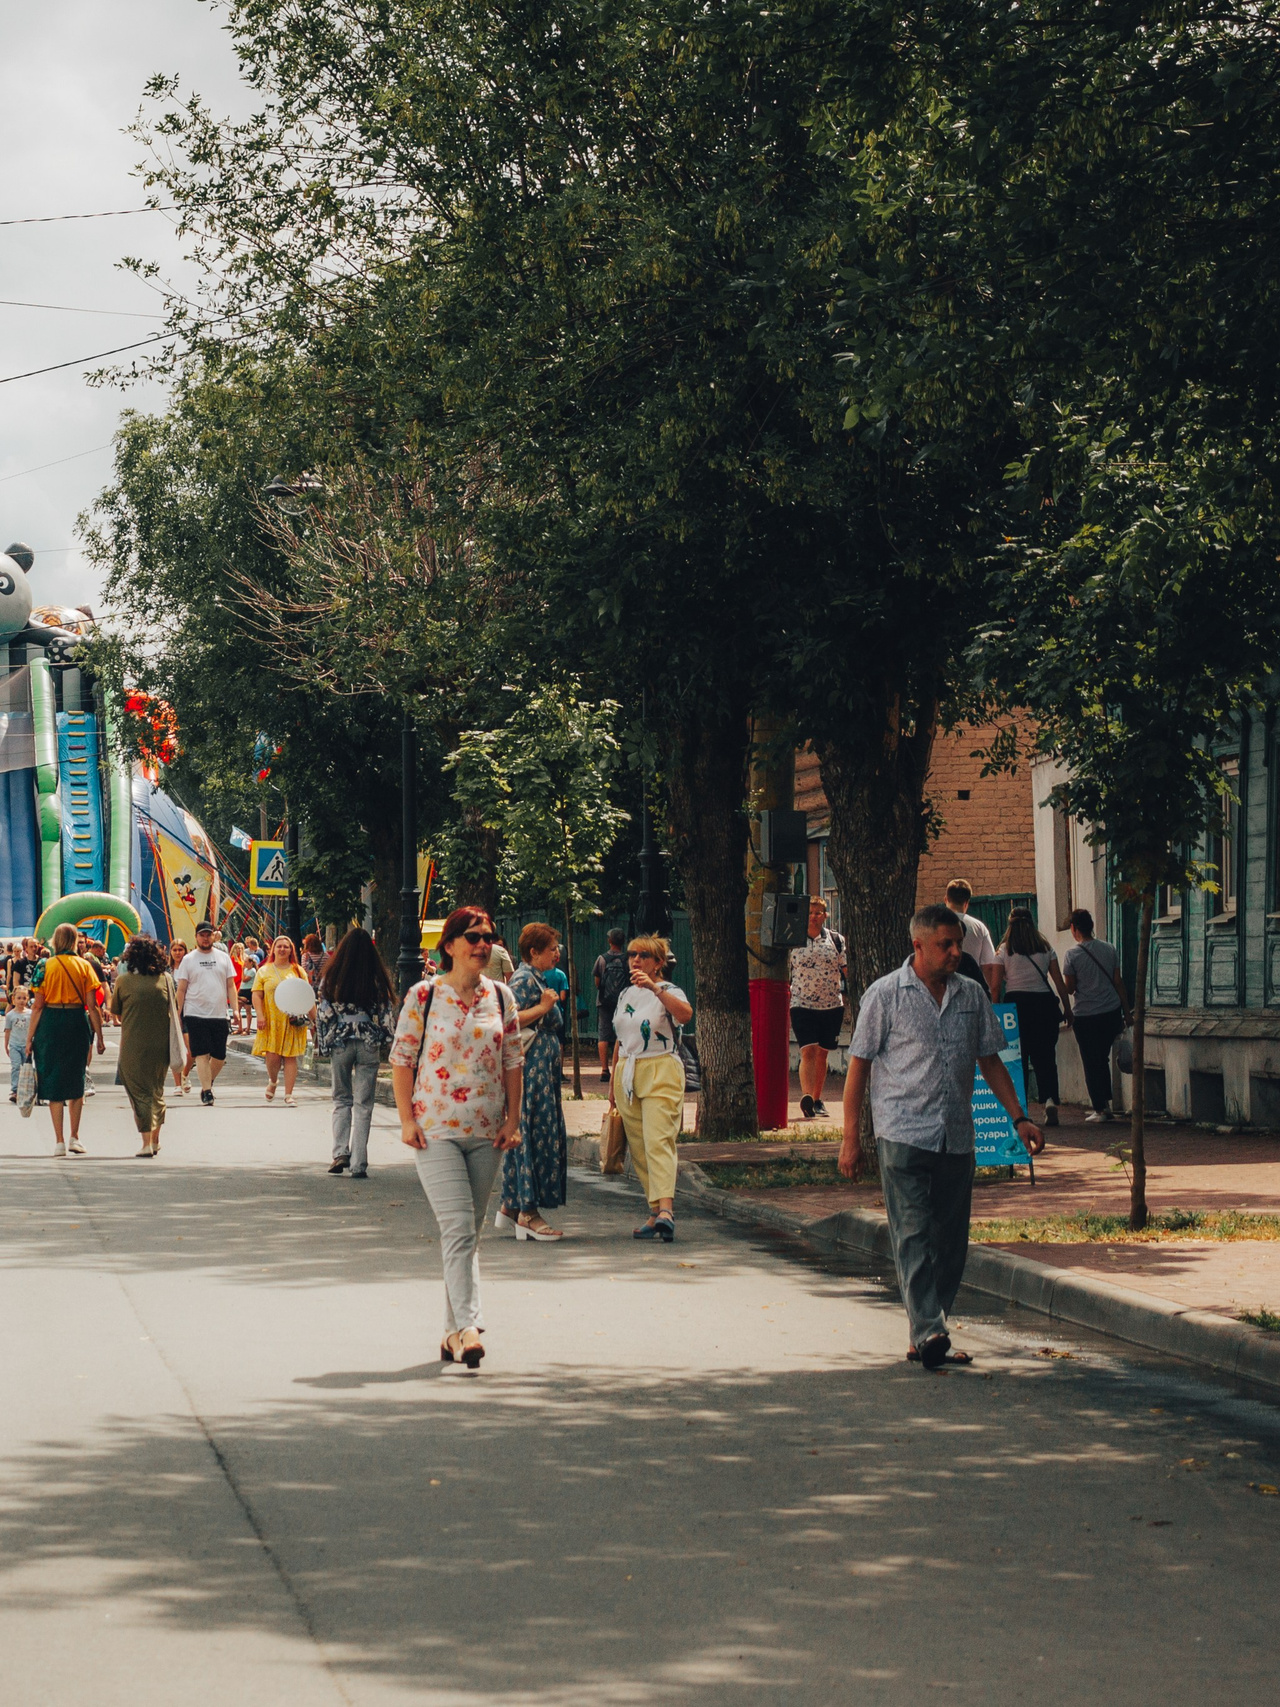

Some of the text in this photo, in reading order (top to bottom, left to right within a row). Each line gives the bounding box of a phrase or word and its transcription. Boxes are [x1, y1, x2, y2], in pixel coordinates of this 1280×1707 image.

[971, 1102, 998, 1112] ушки
[973, 1115, 1008, 1126] ировка
[974, 1130, 1009, 1141] суары
[974, 1145, 996, 1153] еска
